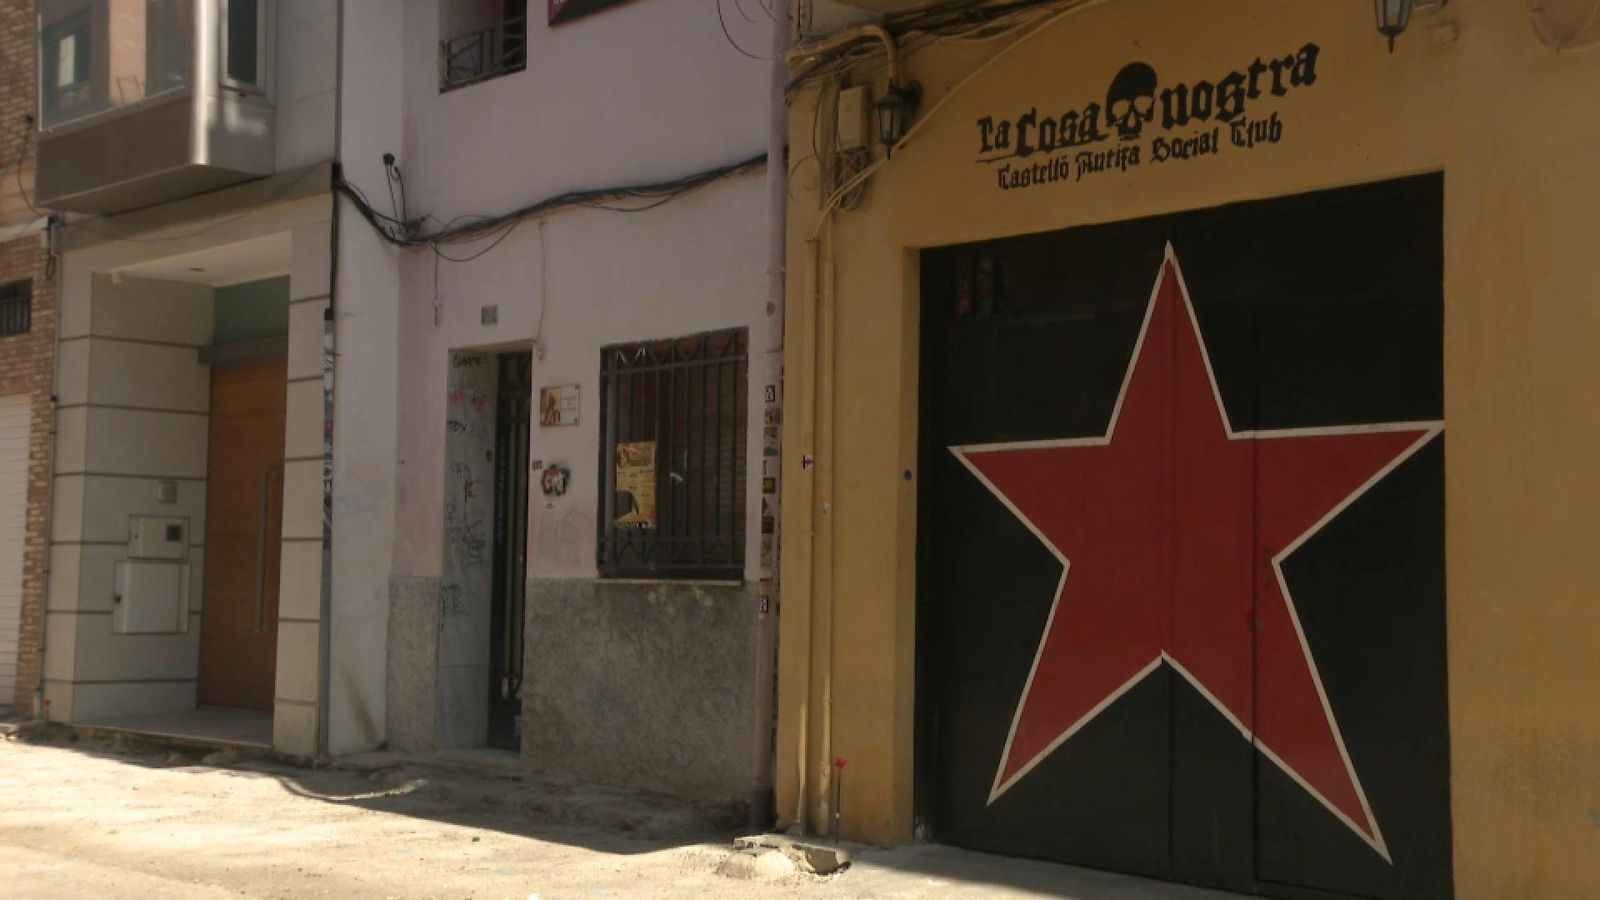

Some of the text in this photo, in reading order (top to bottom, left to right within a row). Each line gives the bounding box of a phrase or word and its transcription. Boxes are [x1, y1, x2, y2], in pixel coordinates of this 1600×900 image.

[977, 43, 1320, 157] La Cosa nostra
[1076, 145, 1140, 181] Antifa
[1150, 128, 1219, 162] Social
[1230, 112, 1283, 149] Club
